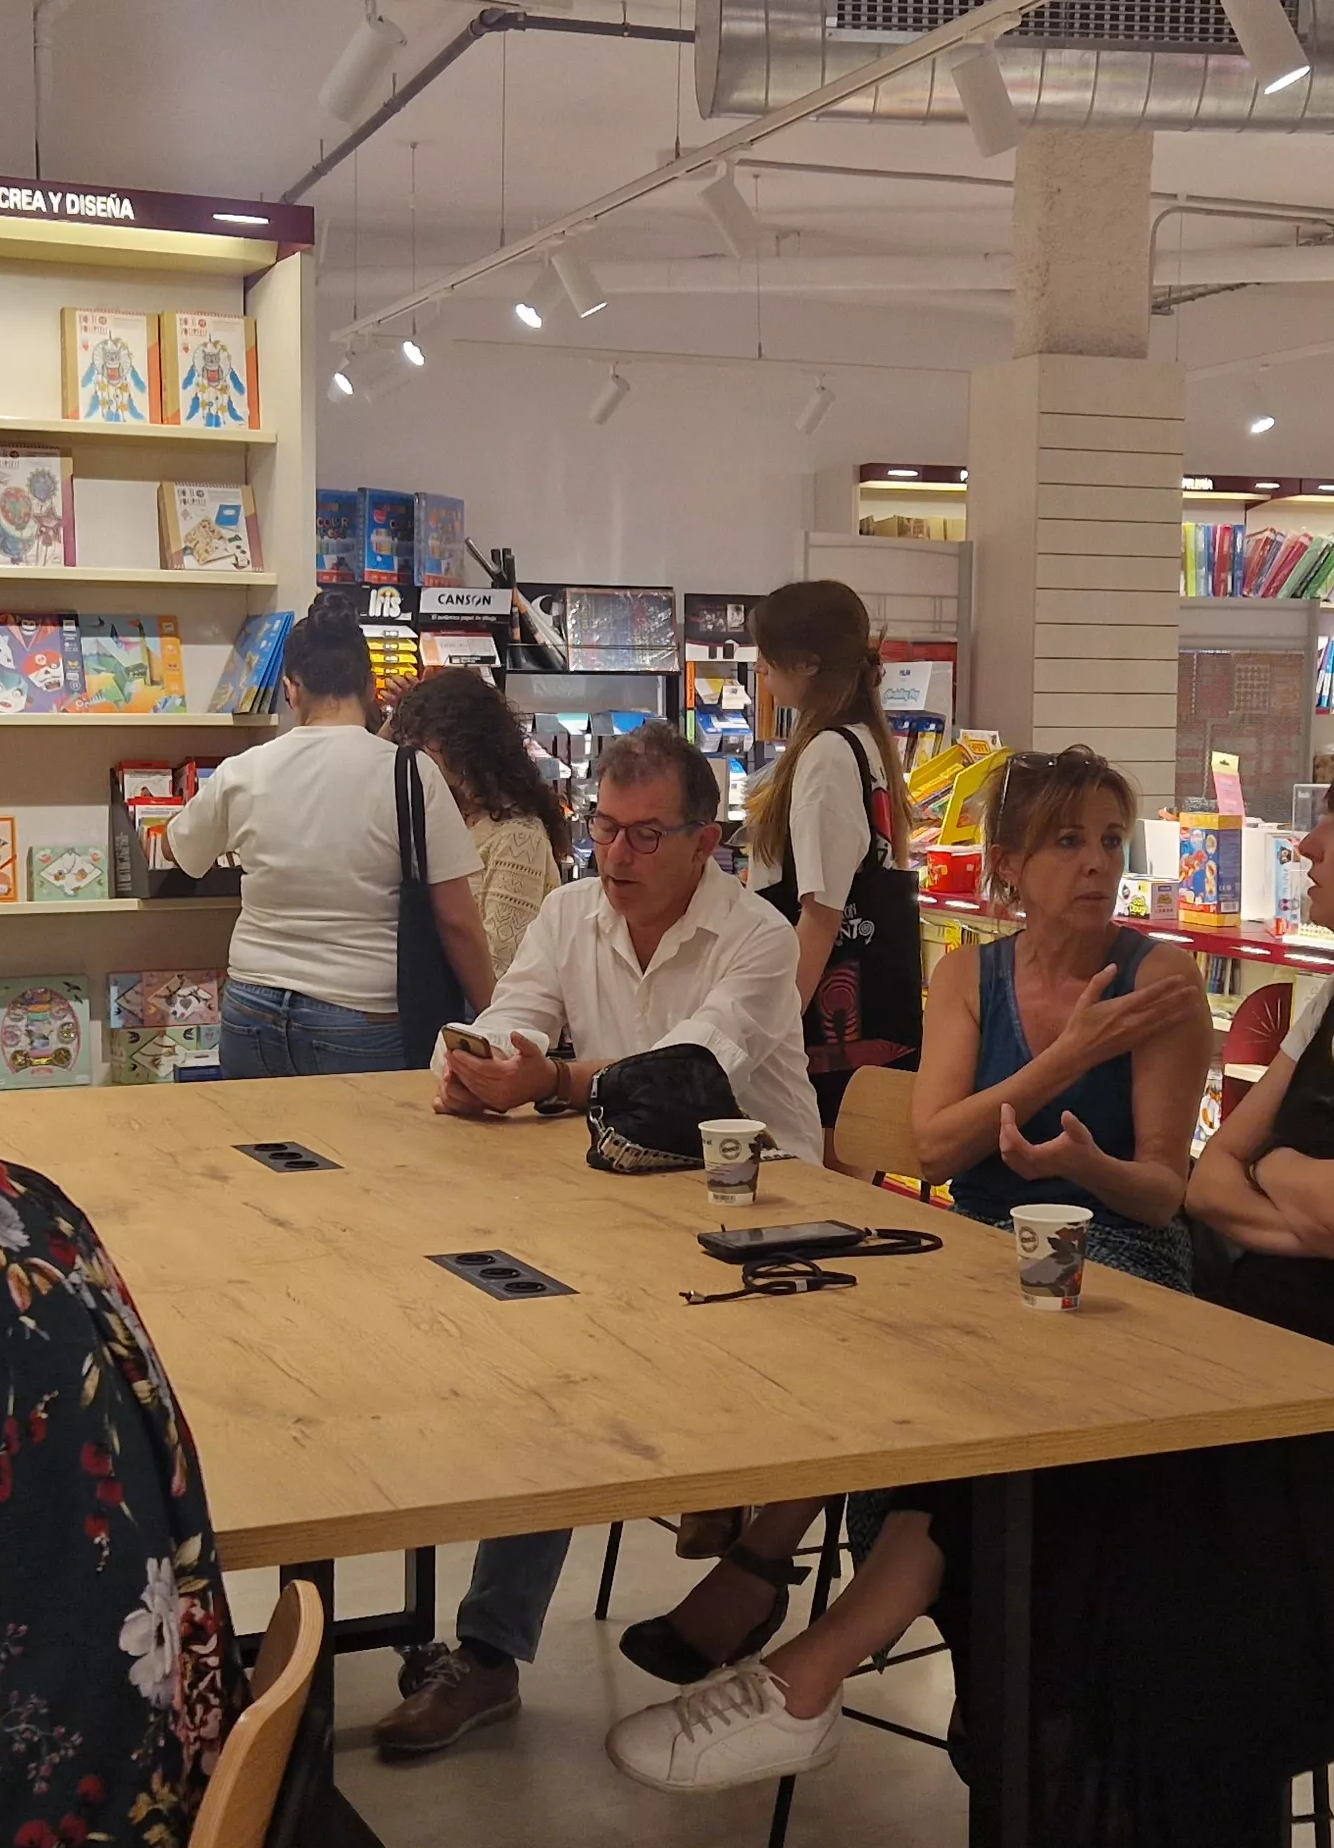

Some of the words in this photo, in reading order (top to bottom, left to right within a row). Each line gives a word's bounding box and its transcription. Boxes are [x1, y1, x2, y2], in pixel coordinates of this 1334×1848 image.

[48, 192, 63, 213] Y
[66, 193, 135, 220] DISEÑA
[438, 593, 492, 607] CANSON
